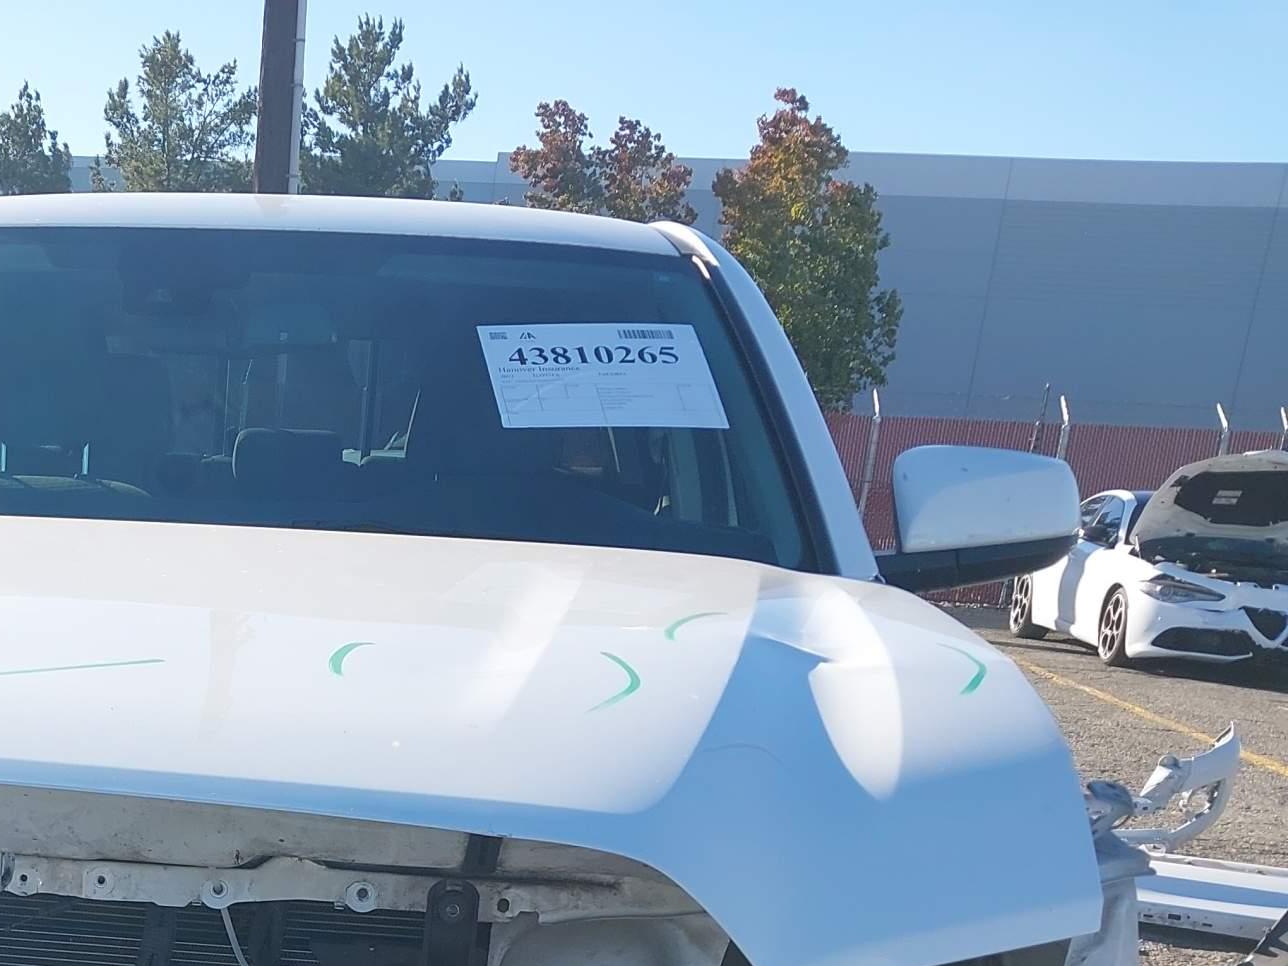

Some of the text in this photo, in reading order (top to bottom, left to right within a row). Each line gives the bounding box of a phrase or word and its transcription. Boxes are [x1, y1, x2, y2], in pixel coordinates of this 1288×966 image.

[509, 345, 680, 366] 43810265
[498, 365, 581, 374] Hanover Insurance
